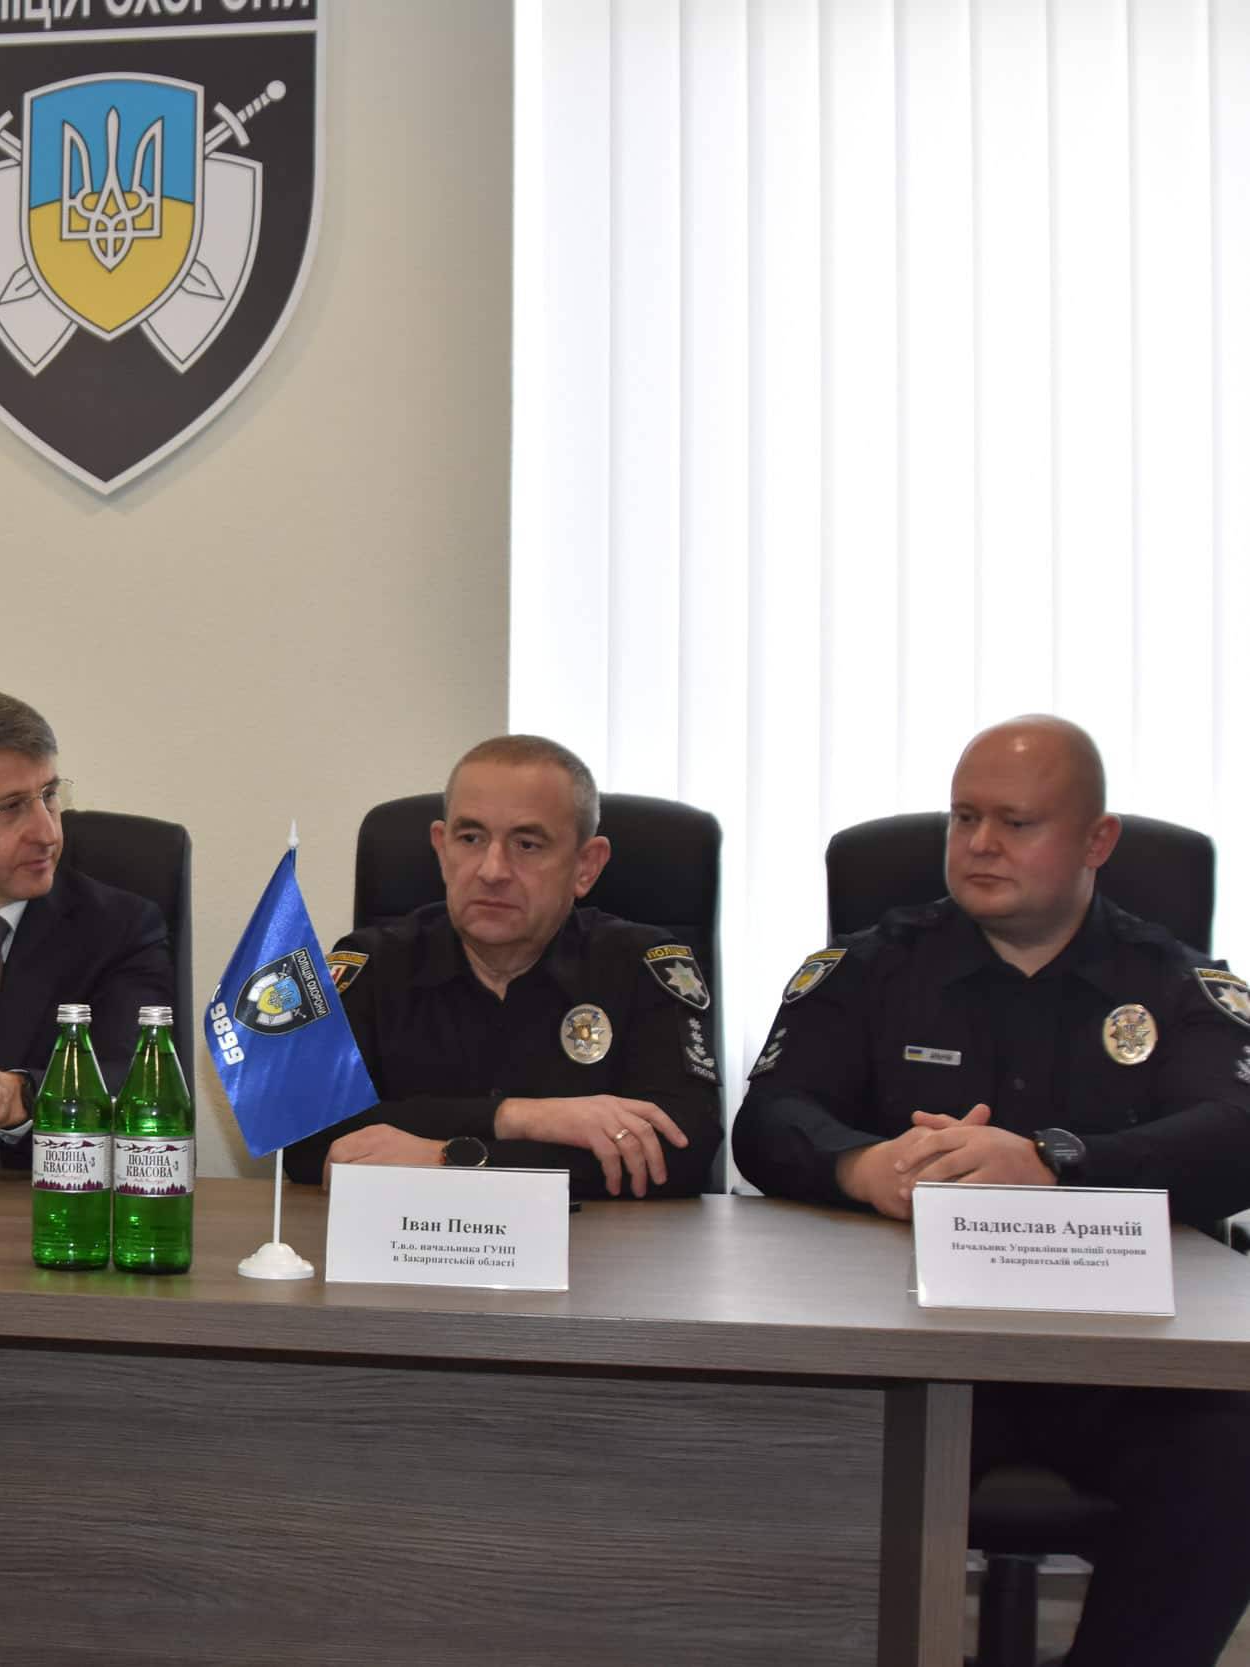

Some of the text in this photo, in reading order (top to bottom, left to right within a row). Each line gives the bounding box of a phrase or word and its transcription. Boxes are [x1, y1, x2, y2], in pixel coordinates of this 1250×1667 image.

[295, 950, 328, 1016] ПОЛІЦІЯ ОХОРОНИ
[210, 1002, 245, 1066] 9899
[45, 1150, 87, 1162] ПОЛЯНА
[128, 1154, 171, 1167] ПОЛЯНА
[43, 1161, 89, 1174] КВАСОВА
[126, 1166, 173, 1178] КВАСОВА
[401, 1216, 508, 1235] Іван Пеняк
[953, 1216, 1143, 1239] Владислав Аранчій
[420, 1244, 480, 1254] начальника
[483, 1245, 516, 1255] ГУНП
[951, 1241, 1147, 1257] Начальник Управління поліції охорони
[403, 1254, 475, 1266] Закарпатській
[477, 1257, 516, 1267] області
[999, 1255, 1071, 1267] Закарпатській
[1073, 1257, 1110, 1267] області
